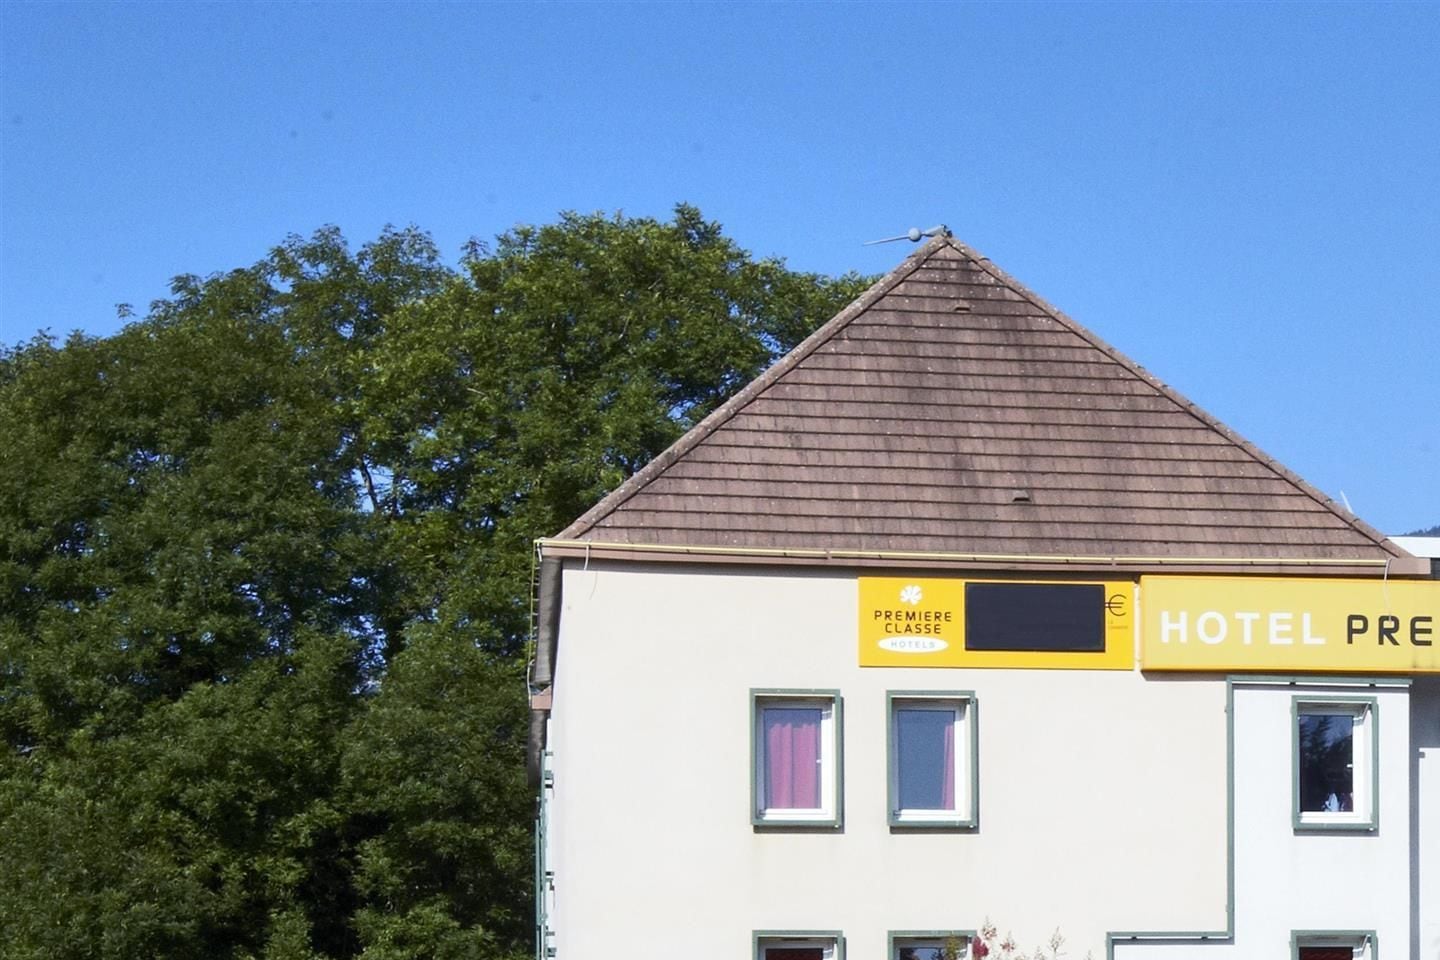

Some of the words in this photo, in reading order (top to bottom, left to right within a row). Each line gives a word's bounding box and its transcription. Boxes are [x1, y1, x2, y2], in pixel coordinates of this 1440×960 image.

[873, 610, 952, 622] PREMIERE
[884, 623, 942, 634] CLASSE
[1160, 610, 1327, 645] HOTEL
[890, 640, 936, 649] HOTELS
